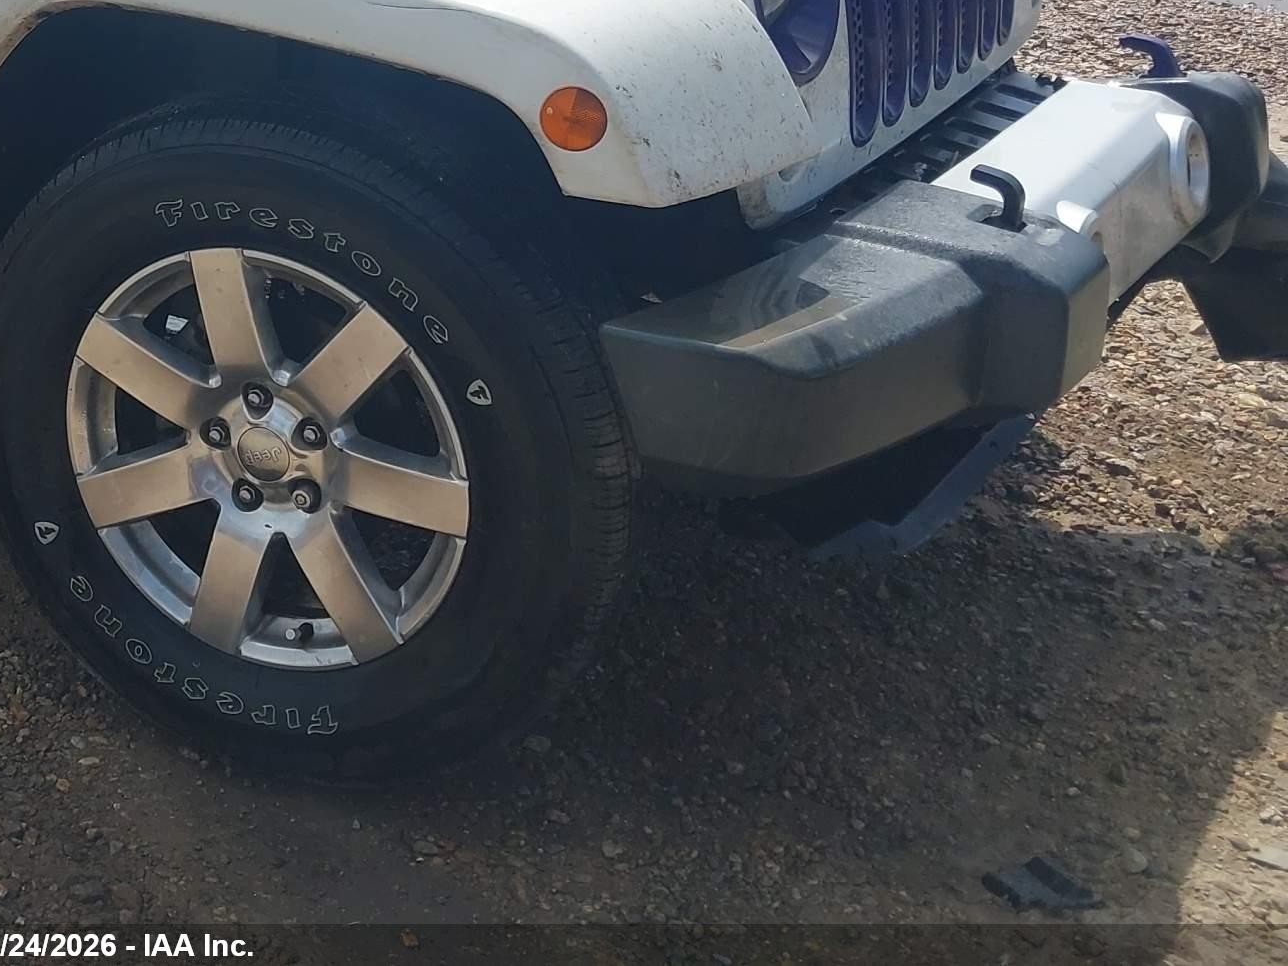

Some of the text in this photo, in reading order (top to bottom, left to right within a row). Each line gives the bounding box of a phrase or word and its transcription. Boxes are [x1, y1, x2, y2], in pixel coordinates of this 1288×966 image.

[155, 198, 449, 344] Firestone
[245, 445, 282, 466] Jeep
[70, 575, 339, 735] Firestone
